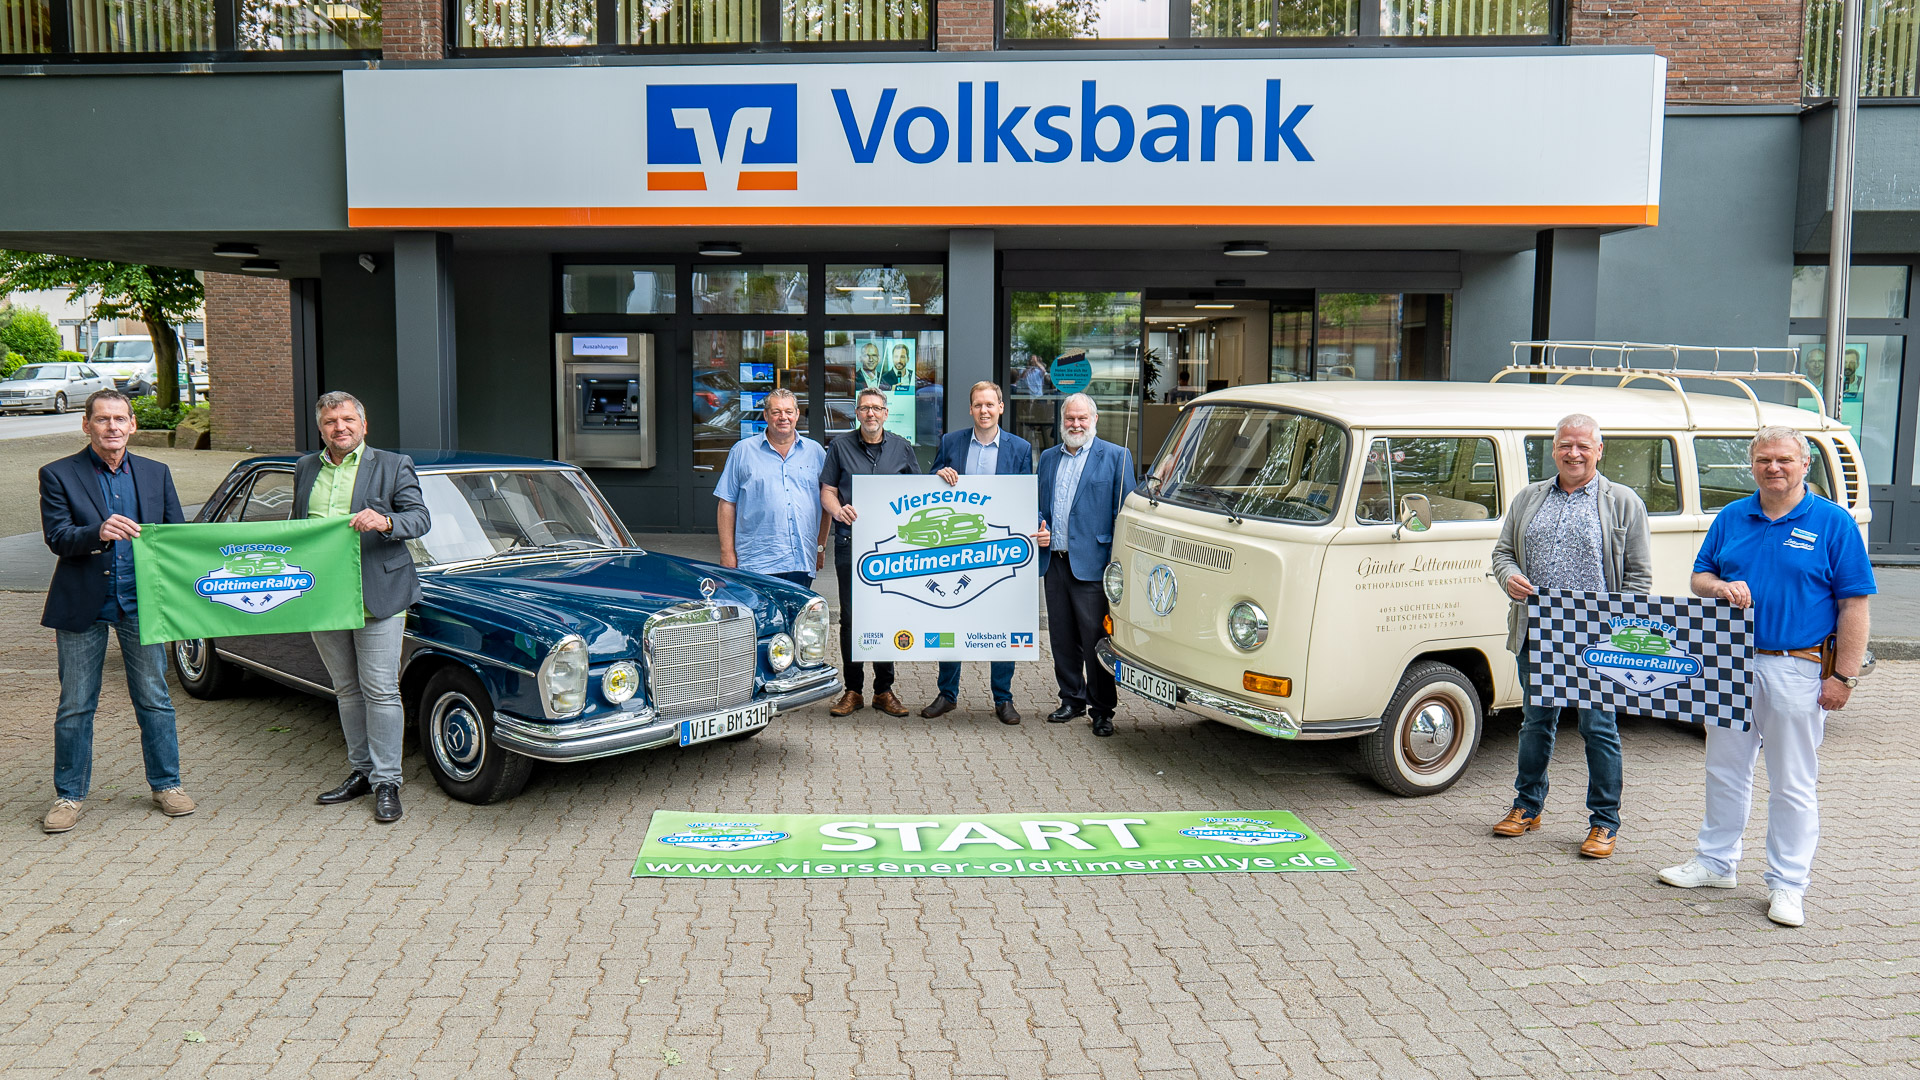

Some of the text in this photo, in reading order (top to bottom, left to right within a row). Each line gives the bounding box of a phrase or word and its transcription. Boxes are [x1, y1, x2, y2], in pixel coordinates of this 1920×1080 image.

[831, 79, 1316, 164] Volksbank
[582, 343, 619, 351] Auszahlungen
[889, 490, 992, 515] Viersener
[219, 543, 293, 557] Viersener
[869, 543, 1022, 577] OldtimerRallye
[1357, 554, 1482, 579] Günter Lettermann
[202, 576, 308, 593] OldtimerRallye
[1607, 615, 1678, 634] Viersener
[965, 640, 1007, 649] Viersen eG
[966, 632, 1007, 640] Volksbank
[1589, 652, 1694, 673] OldtimerRallye
[1121, 664, 1136, 686] VIE
[1142, 674, 1153, 693] OT
[1156, 680, 1175, 702] 63H
[691, 718, 717, 741] VIE
[727, 712, 743, 732] BM
[745, 705, 768, 728] 31H
[666, 833, 781, 843] OldtimerRallye
[819, 819, 1147, 852] START
[1187, 829, 1297, 838] OldtimerRallye
[645, 853, 1338, 874] www.viersener-oldtimerrallye.de
